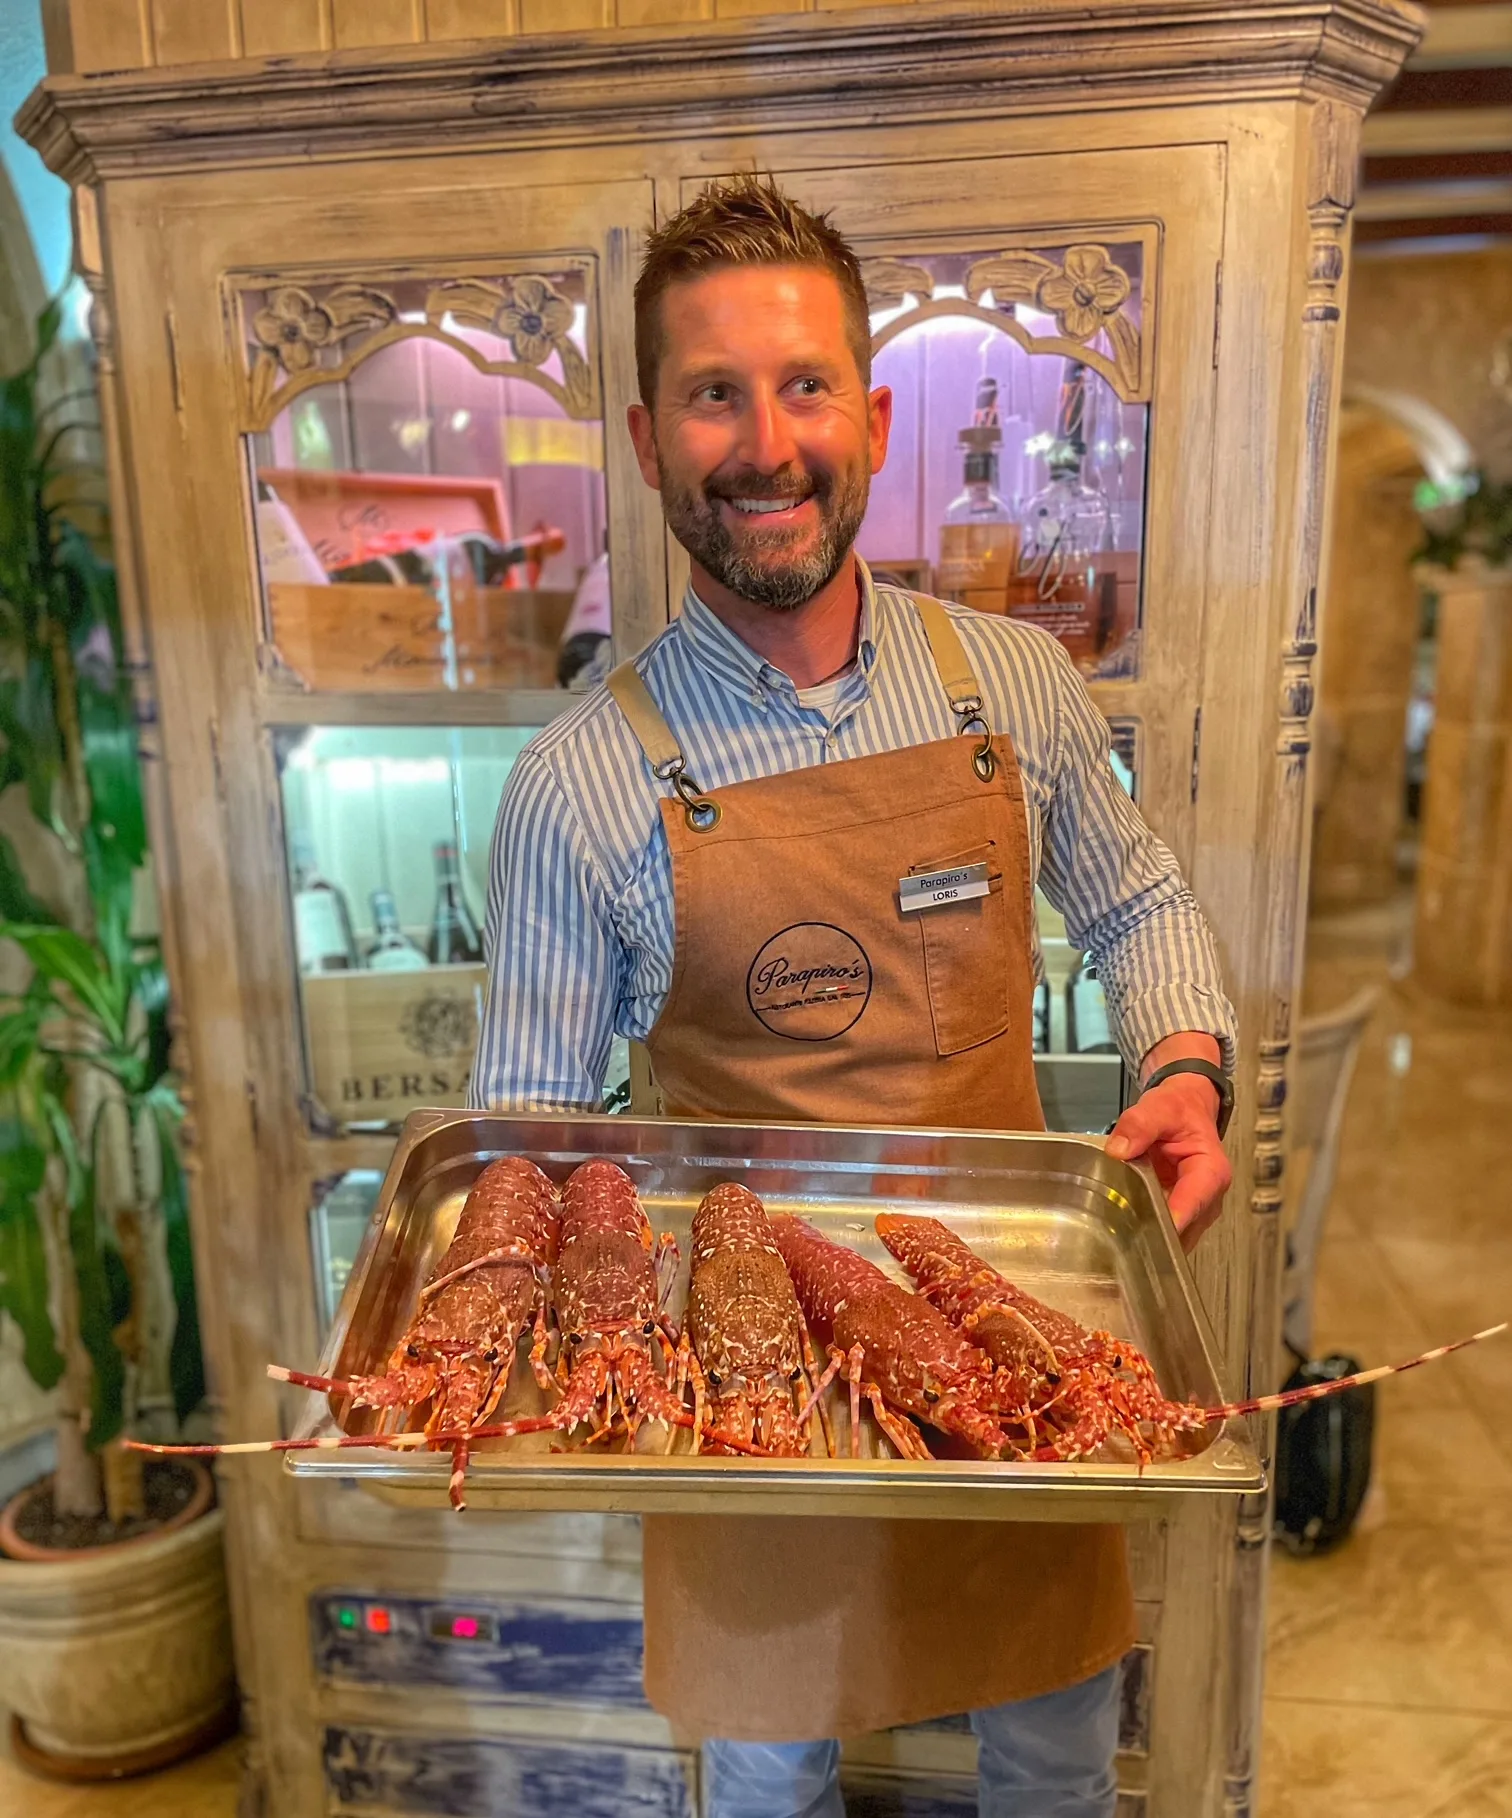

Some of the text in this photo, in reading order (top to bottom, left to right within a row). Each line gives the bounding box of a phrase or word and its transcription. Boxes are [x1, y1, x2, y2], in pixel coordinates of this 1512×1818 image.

[920, 872, 968, 889] Parapiro's
[932, 889, 959, 901] LORIS
[754, 957, 864, 995] Parapiro's
